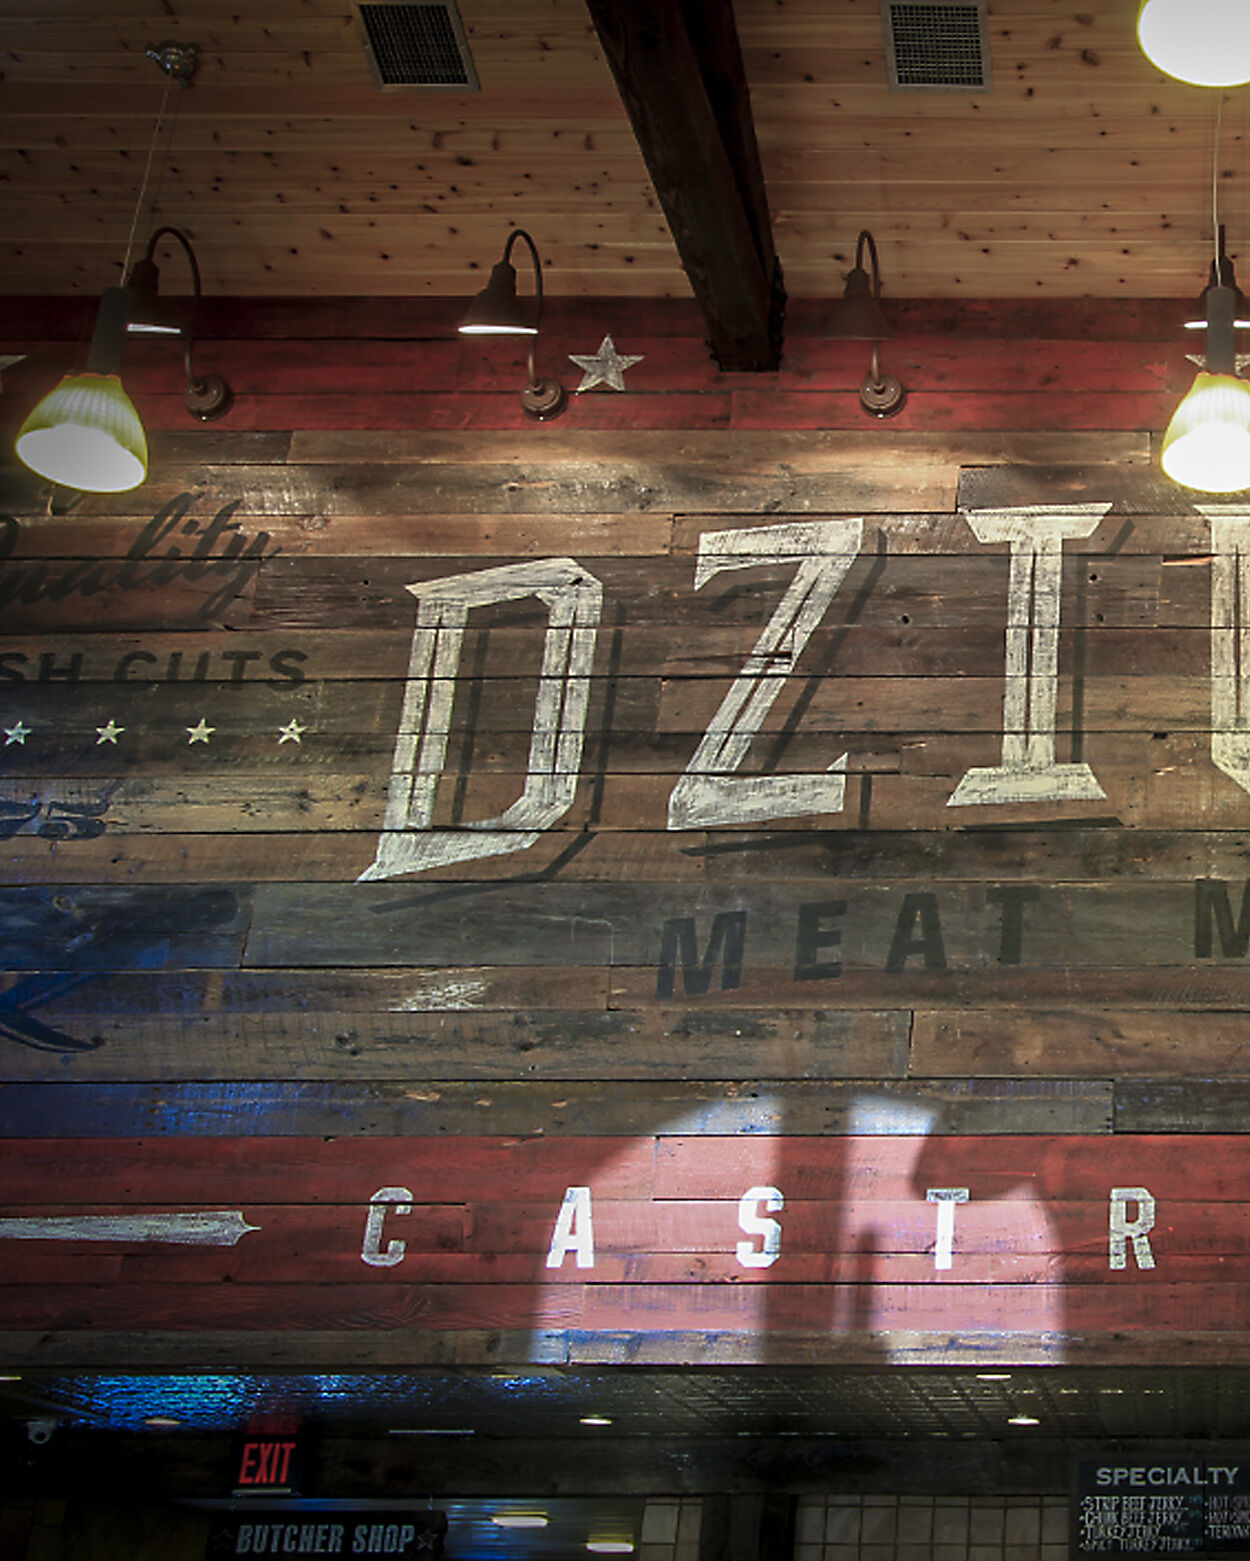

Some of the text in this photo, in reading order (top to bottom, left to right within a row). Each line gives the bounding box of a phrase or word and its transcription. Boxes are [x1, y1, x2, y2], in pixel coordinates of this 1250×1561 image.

[0, 492, 282, 622] uality
[113, 650, 309, 692] CUTS
[656, 885, 1039, 1000] MEAT
[237, 1442, 296, 1485] EXIT
[1096, 1466, 1239, 1486] SPECIALTY
[235, 1524, 416, 1555] BUTCHER SHOP
